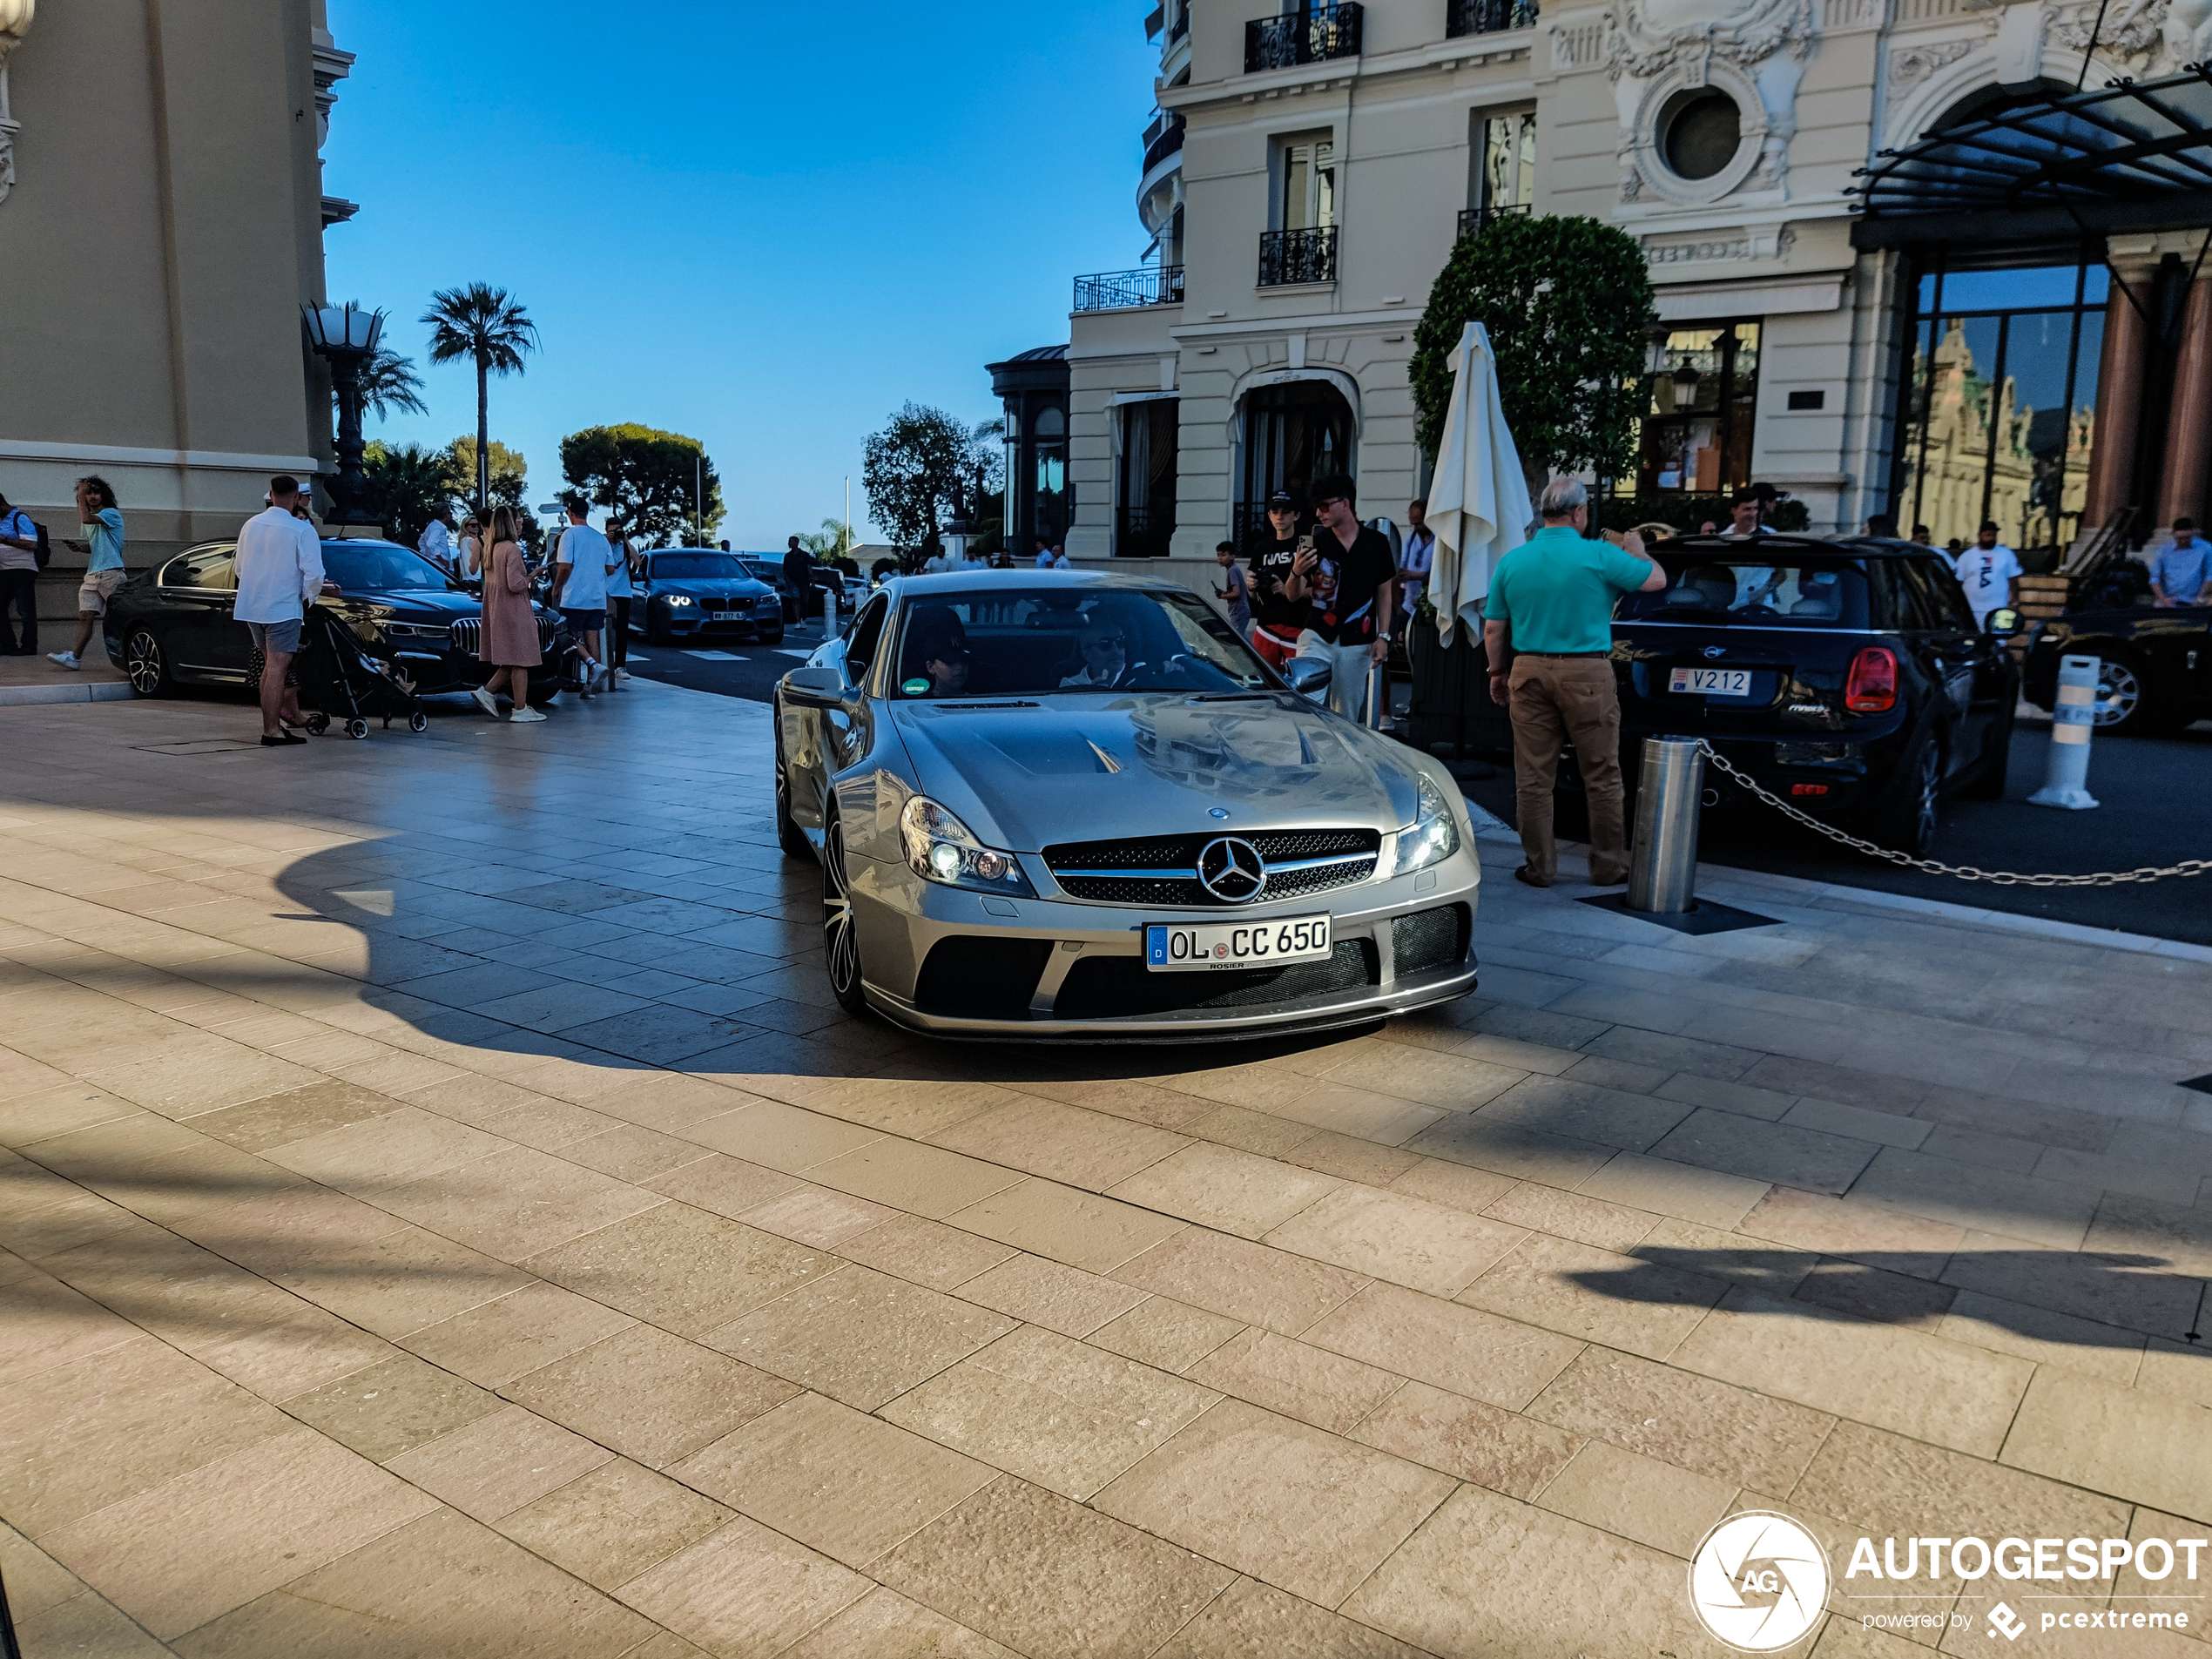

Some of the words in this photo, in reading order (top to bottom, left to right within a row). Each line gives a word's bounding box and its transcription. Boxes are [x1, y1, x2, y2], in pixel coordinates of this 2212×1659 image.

[1979, 557, 1993, 589] FILA
[1694, 671, 1745, 690] V212
[1170, 931, 1210, 960] OL
[1232, 927, 1269, 957] CC
[1278, 921, 1326, 954] 650
[1155, 949, 1163, 958] D
